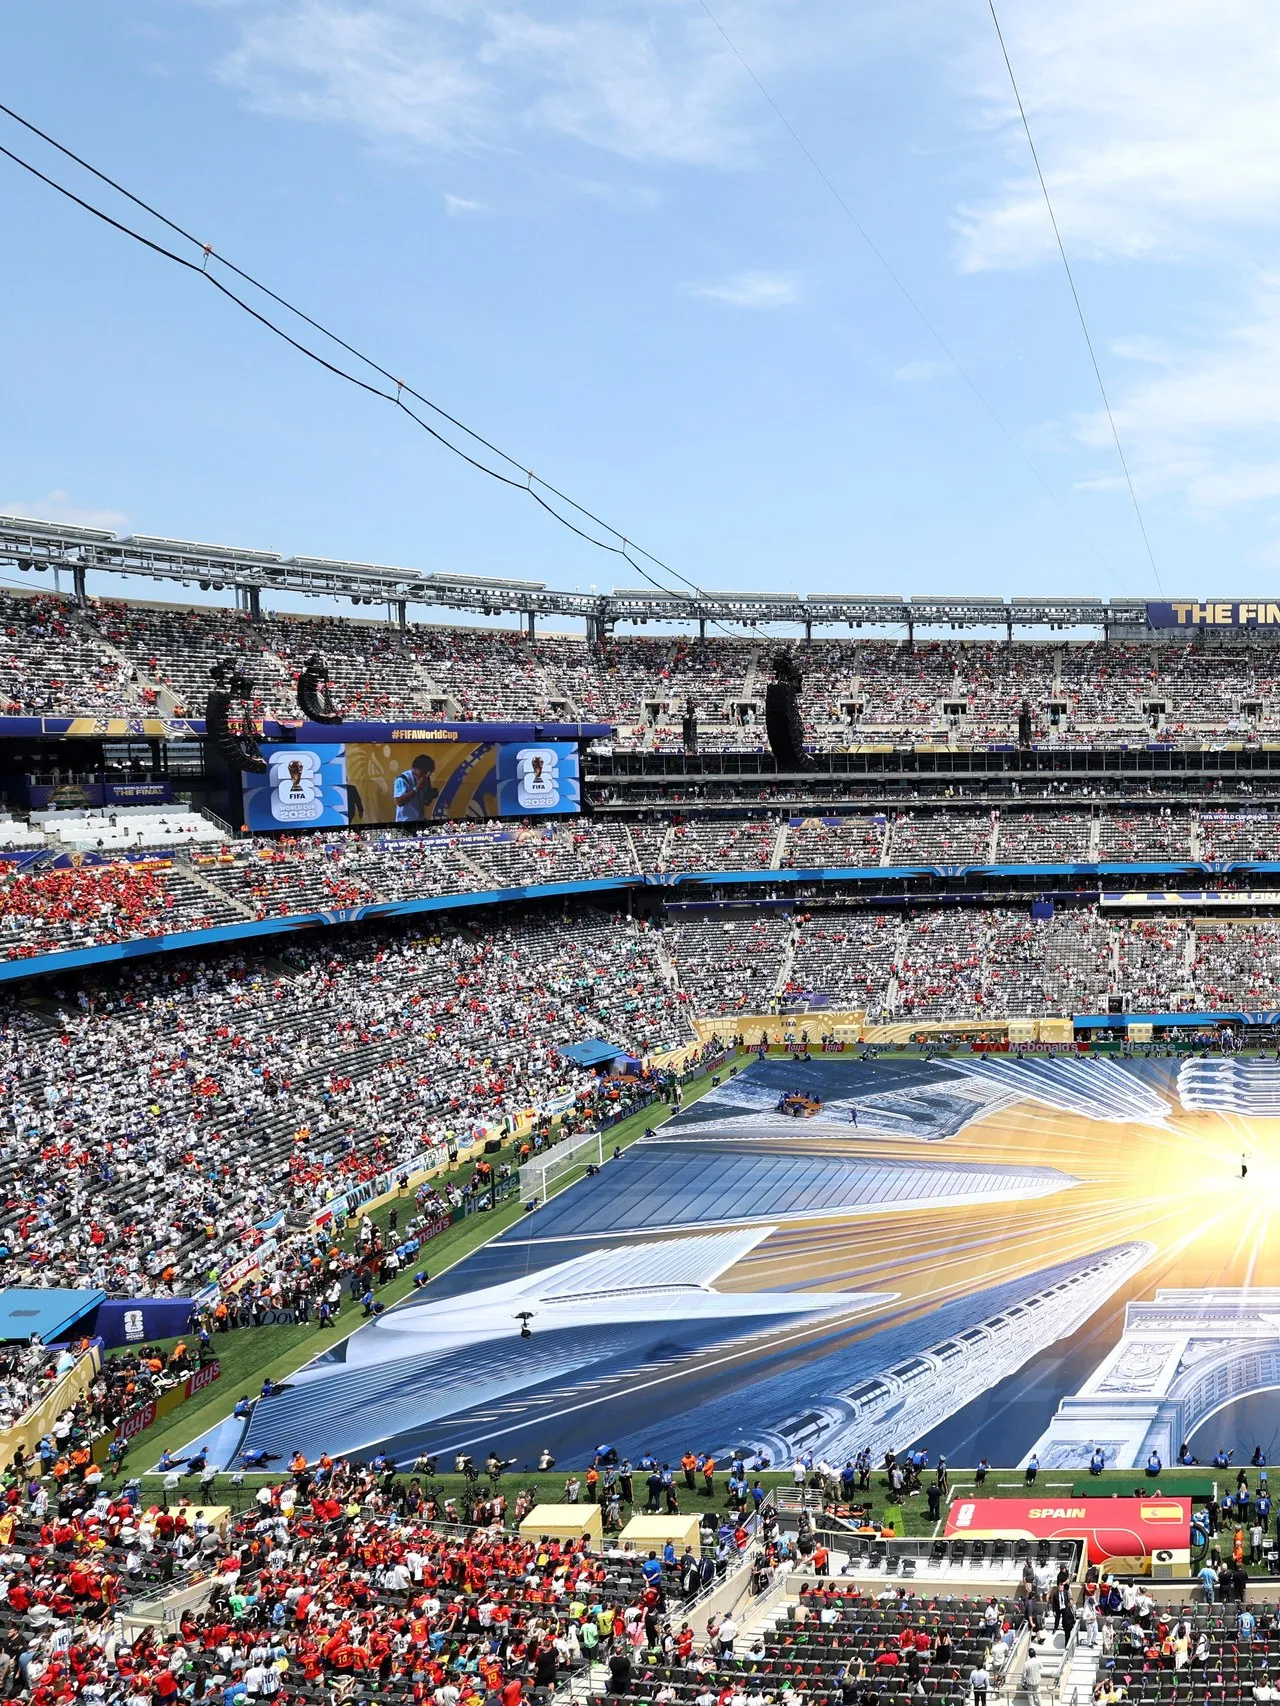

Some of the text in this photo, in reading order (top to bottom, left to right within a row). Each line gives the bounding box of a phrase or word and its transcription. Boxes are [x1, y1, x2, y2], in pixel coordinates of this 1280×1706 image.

[1171, 603, 1233, 624] THE
[391, 729, 458, 741] #FIFAWorldCup
[136, 788, 165, 796] FINAL
[525, 798, 554, 806] 2026
[280, 810, 316, 819] 2026
[1217, 892, 1249, 900] THE
[866, 1044, 891, 1052] Dove
[919, 1044, 944, 1052] Dove
[1008, 1042, 1079, 1052] McDonald's
[1120, 1041, 1176, 1051] Hisense
[621, 1103, 646, 1120] ULTRA
[465, 1176, 517, 1217] Hinse
[260, 1310, 293, 1325] Dov
[191, 1361, 220, 1395] Lay's
[120, 1407, 152, 1440] Lay's
[1028, 1507, 1087, 1519] SPAIN
[415, 1625, 422, 1635] 5
[57, 1633, 69, 1647] 10
[263, 1673, 274, 1684] 10
[487, 1672, 498, 1685] 19
